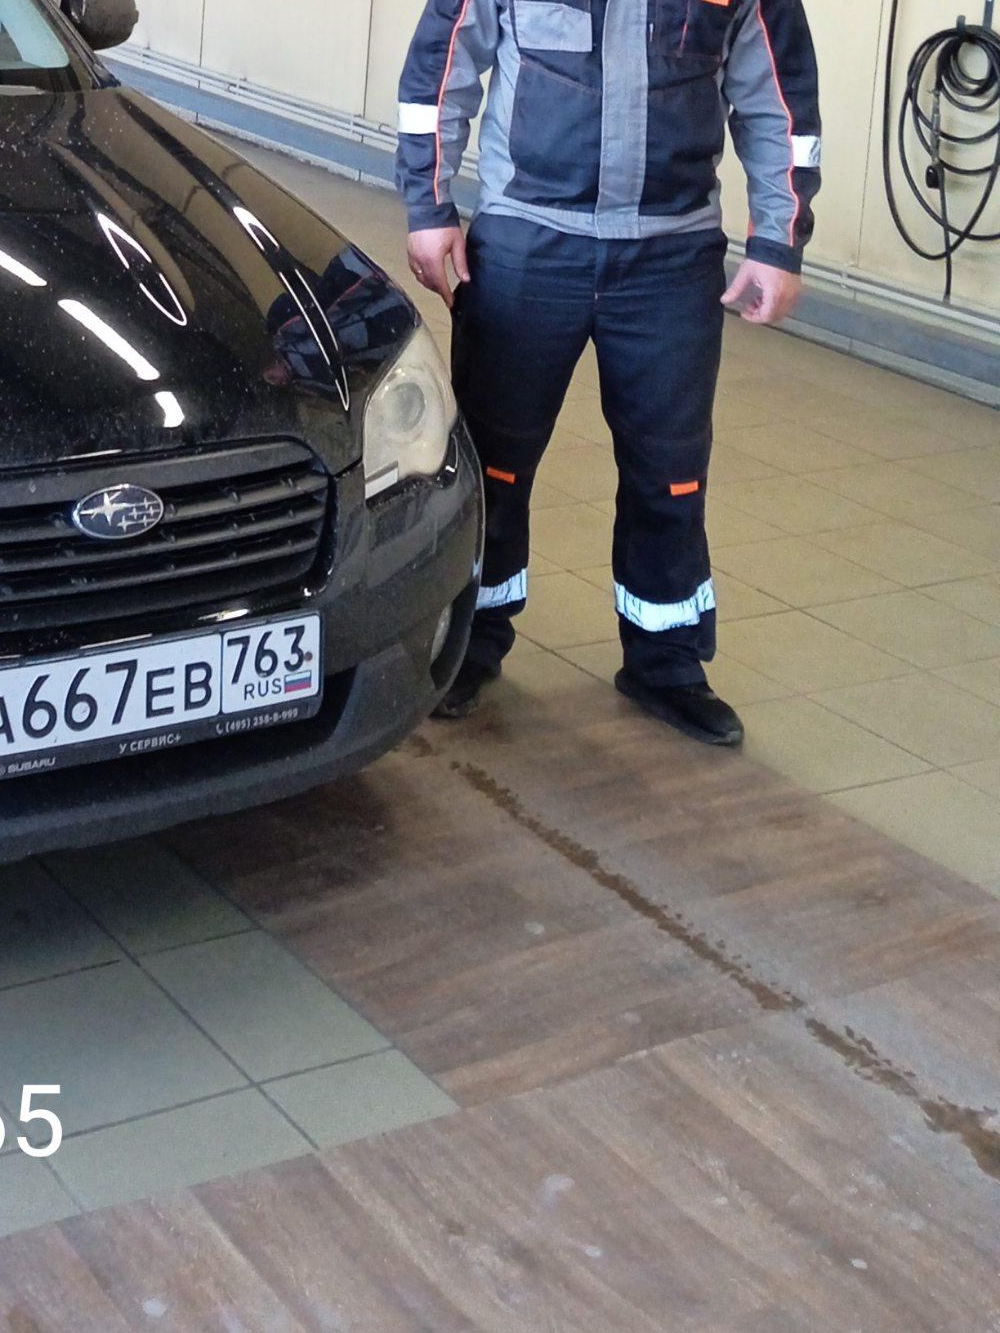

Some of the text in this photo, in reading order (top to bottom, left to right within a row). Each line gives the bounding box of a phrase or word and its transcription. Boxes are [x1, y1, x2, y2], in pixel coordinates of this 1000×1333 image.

[227, 625, 305, 685] 763
[244, 678, 282, 701] RUS
[7, 756, 56, 774] SUBARU
